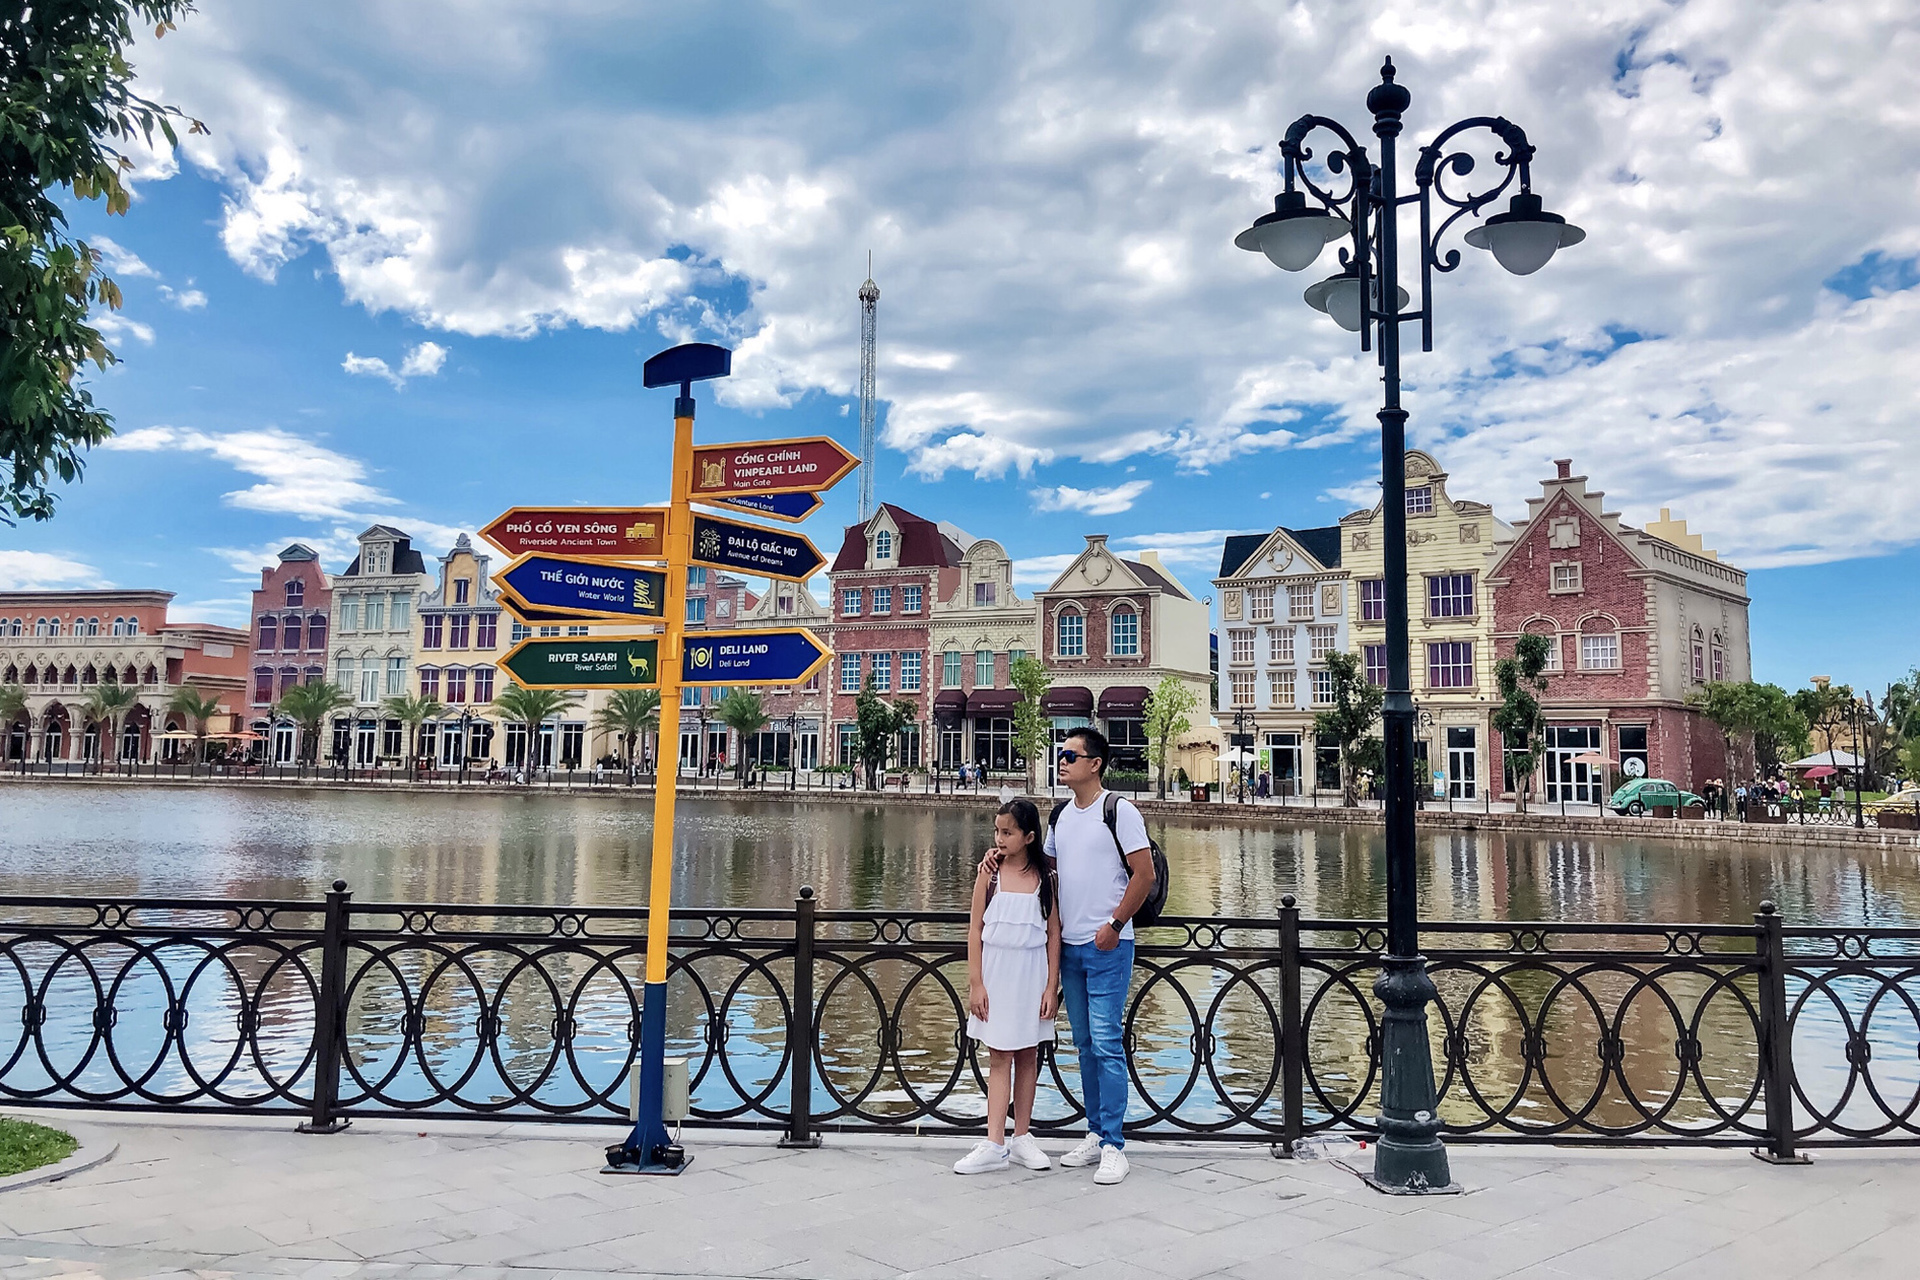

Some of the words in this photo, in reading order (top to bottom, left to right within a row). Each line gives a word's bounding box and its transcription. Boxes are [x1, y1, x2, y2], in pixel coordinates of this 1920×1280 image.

[767, 449, 801, 461] CHÍNH
[734, 466, 785, 478] VINPEARL
[788, 463, 818, 474] LAND
[752, 479, 771, 487] Gate
[759, 502, 774, 511] Land
[506, 520, 532, 533] PHỐ
[556, 524, 580, 533] VEN
[583, 522, 617, 534] SÔNG
[519, 537, 557, 546] Riverside
[560, 538, 593, 546] Ancient
[597, 538, 617, 546] Town
[728, 536, 745, 548] ĐẠI
[783, 547, 798, 557] MƠ
[727, 550, 751, 560] Avenue
[751, 554, 759, 562] of
[760, 556, 783, 566] Dreams
[540, 569, 563, 583] THẾ
[565, 573, 588, 586] GIỚI
[591, 577, 625, 590] NƯỚC
[578, 590, 600, 600] Water
[603, 593, 624, 602] World
[720, 645, 740, 655] DELI
[742, 644, 768, 654] LAND
[548, 653, 578, 662] RIVER
[581, 652, 617, 662] SAFARI
[575, 663, 593, 671] River
[595, 663, 617, 671] Safari
[733, 659, 750, 667] Land
